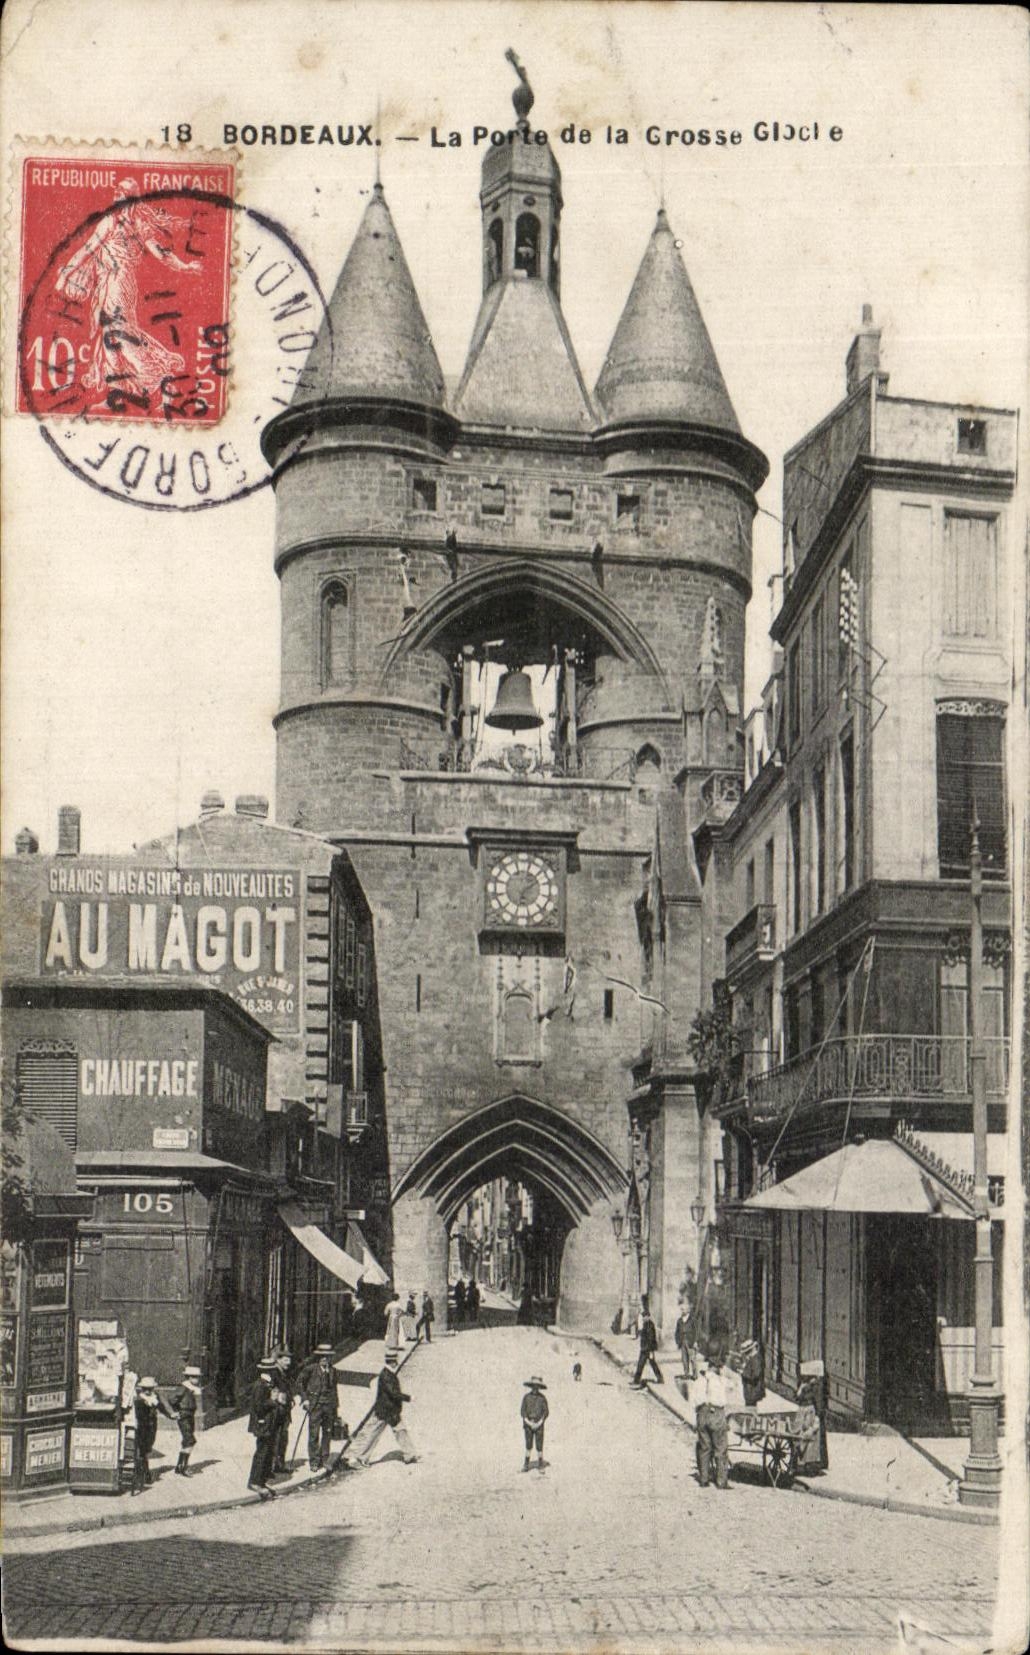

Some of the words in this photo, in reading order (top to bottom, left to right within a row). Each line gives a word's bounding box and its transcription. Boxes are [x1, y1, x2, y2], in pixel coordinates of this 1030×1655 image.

[49, 868, 104, 893] GRANDS
[108, 869, 182, 895] MAGASINS
[184, 874, 201, 896] de
[203, 872, 294, 898] NOUVEAUTES
[45, 901, 109, 970] AU
[127, 903, 297, 973] MAGOT
[80, 1059, 200, 1097] CHAUFFAGE
[123, 1192, 174, 1214] 105
